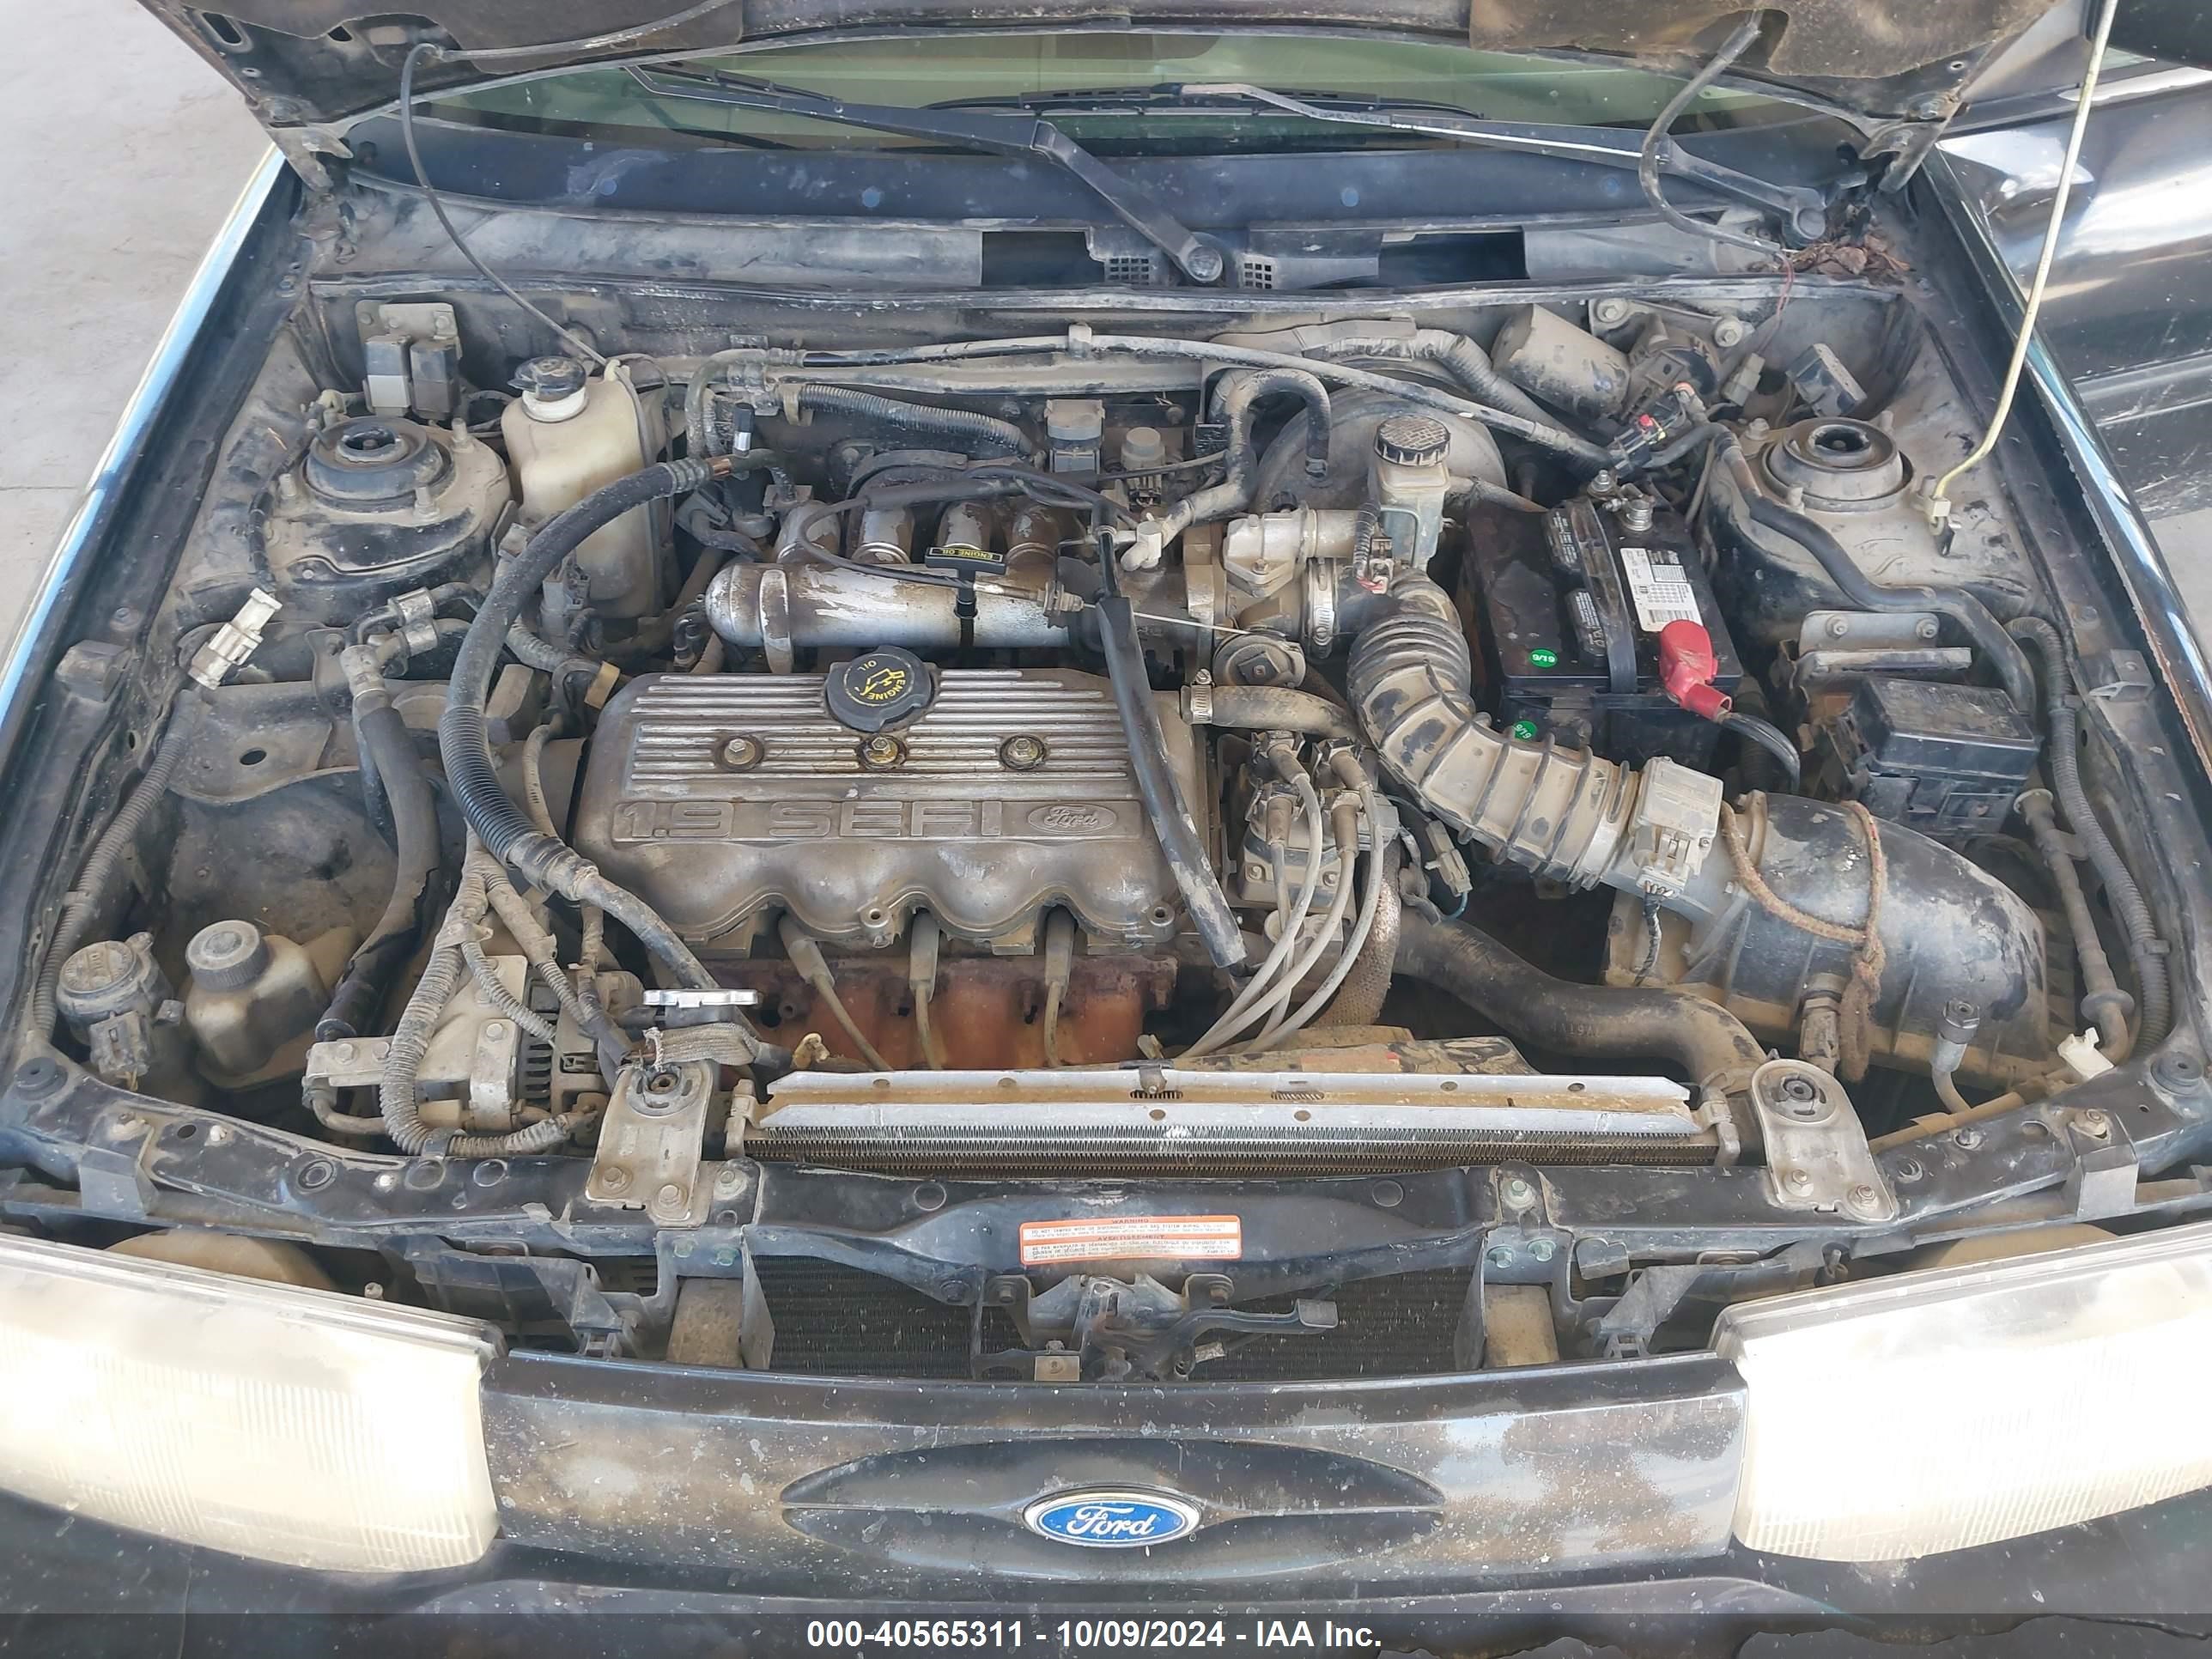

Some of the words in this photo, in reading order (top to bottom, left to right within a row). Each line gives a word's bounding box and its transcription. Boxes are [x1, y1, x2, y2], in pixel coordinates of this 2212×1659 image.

[957, 550, 994, 560] ENGINE
[857, 659, 878, 672] OIL
[866, 679, 906, 701] ENGINE
[622, 801, 734, 838] 1.9
[769, 800, 1003, 837] SEFI
[1042, 805, 1099, 830] Ford
[1066, 1505, 1158, 1535] Ford
